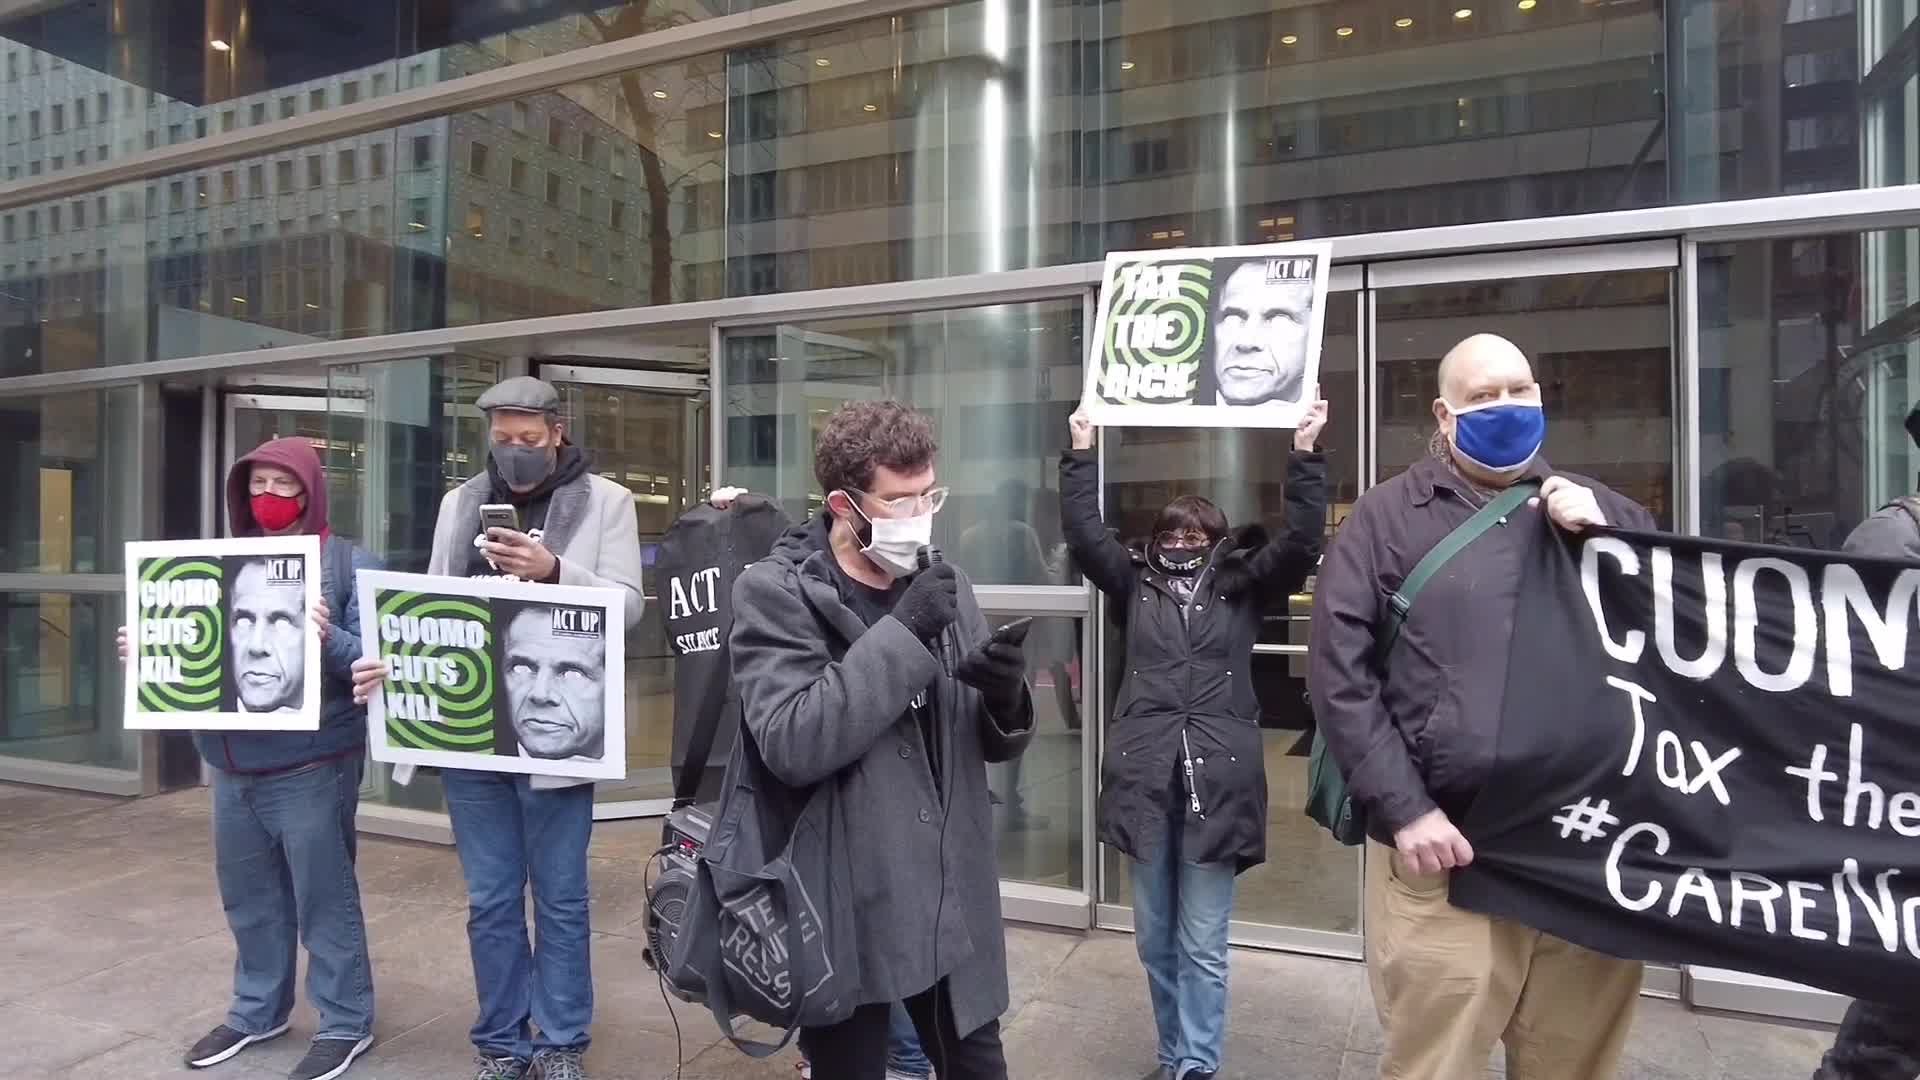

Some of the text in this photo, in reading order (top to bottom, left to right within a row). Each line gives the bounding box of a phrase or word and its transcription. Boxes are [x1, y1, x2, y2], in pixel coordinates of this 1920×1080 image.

[1119, 265, 1181, 300] TAX
[1267, 260, 1311, 279] ACT UP
[1114, 313, 1174, 350] THE
[267, 560, 301, 579] ACT UP
[140, 578, 219, 608] CUOMO
[669, 567, 721, 620] ACT
[140, 618, 197, 645] CUTS
[381, 613, 485, 649] CUOMO
[553, 609, 599, 632] ACT UP
[140, 656, 183, 683] KILL
[384, 653, 458, 687] CUTS
[387, 692, 446, 723] KILL
[1606, 675, 1920, 837] Tax the
